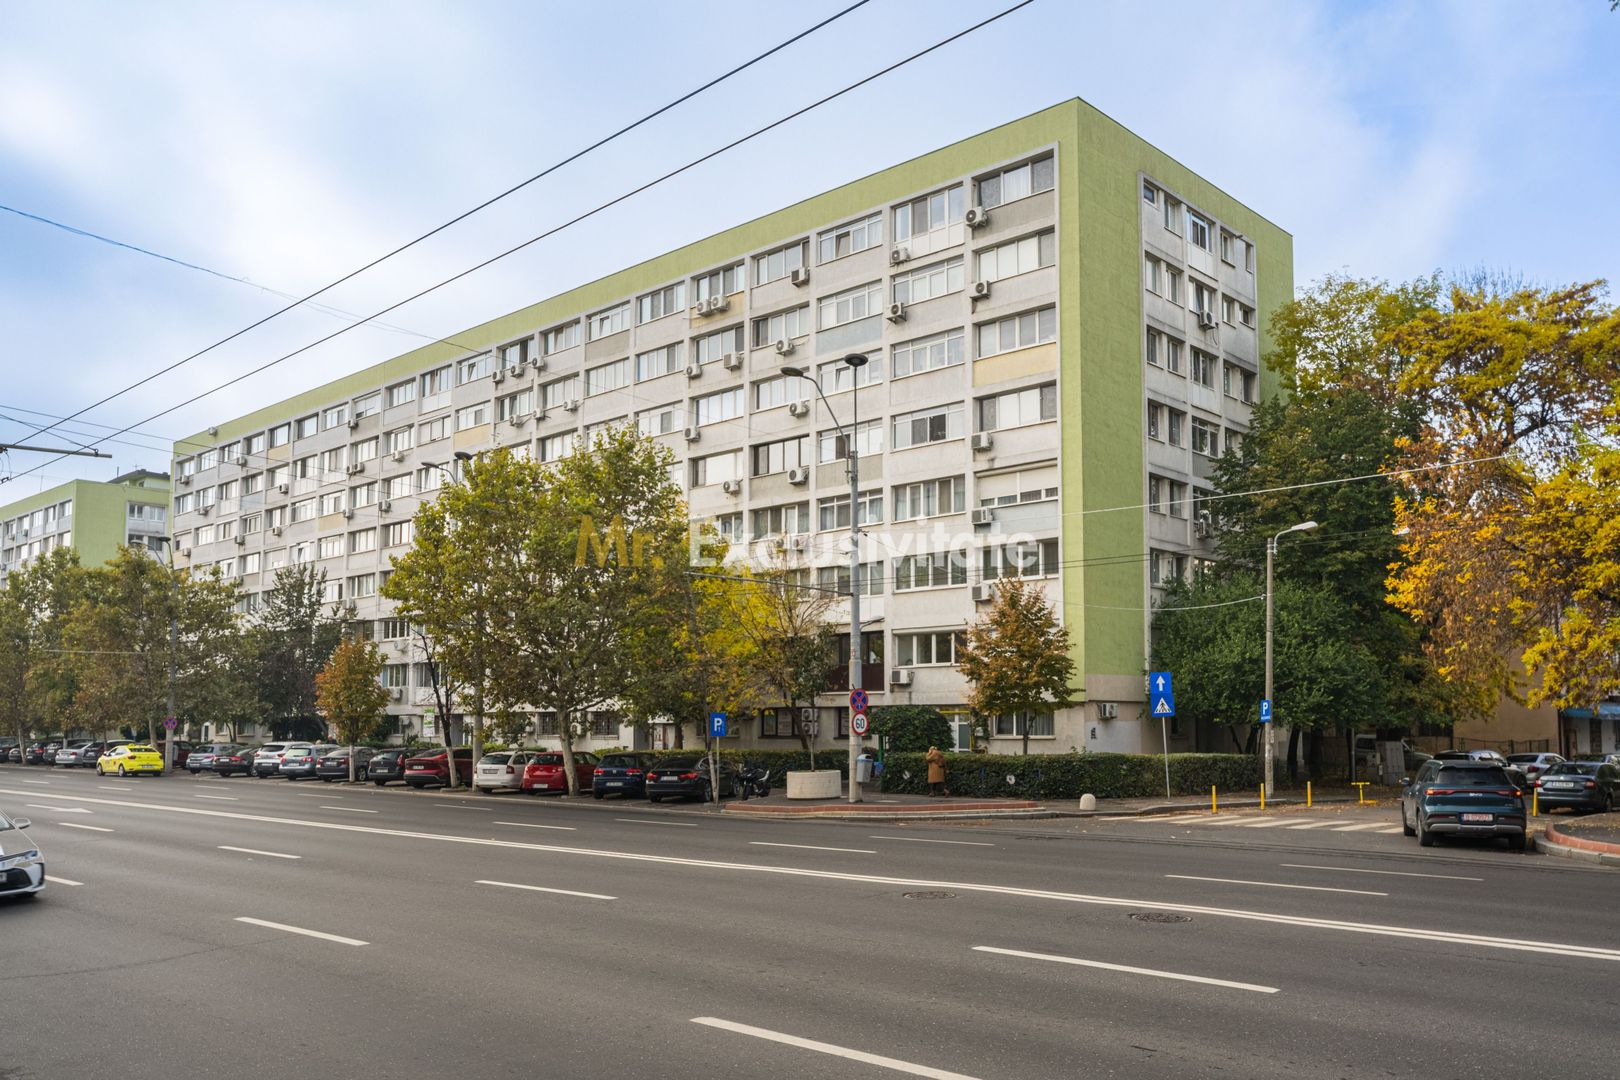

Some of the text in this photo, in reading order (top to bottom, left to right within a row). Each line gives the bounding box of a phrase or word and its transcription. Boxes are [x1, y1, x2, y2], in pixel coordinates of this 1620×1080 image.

[1262, 702, 1269, 715] P
[714, 717, 723, 731] P
[855, 718, 865, 729] 60
